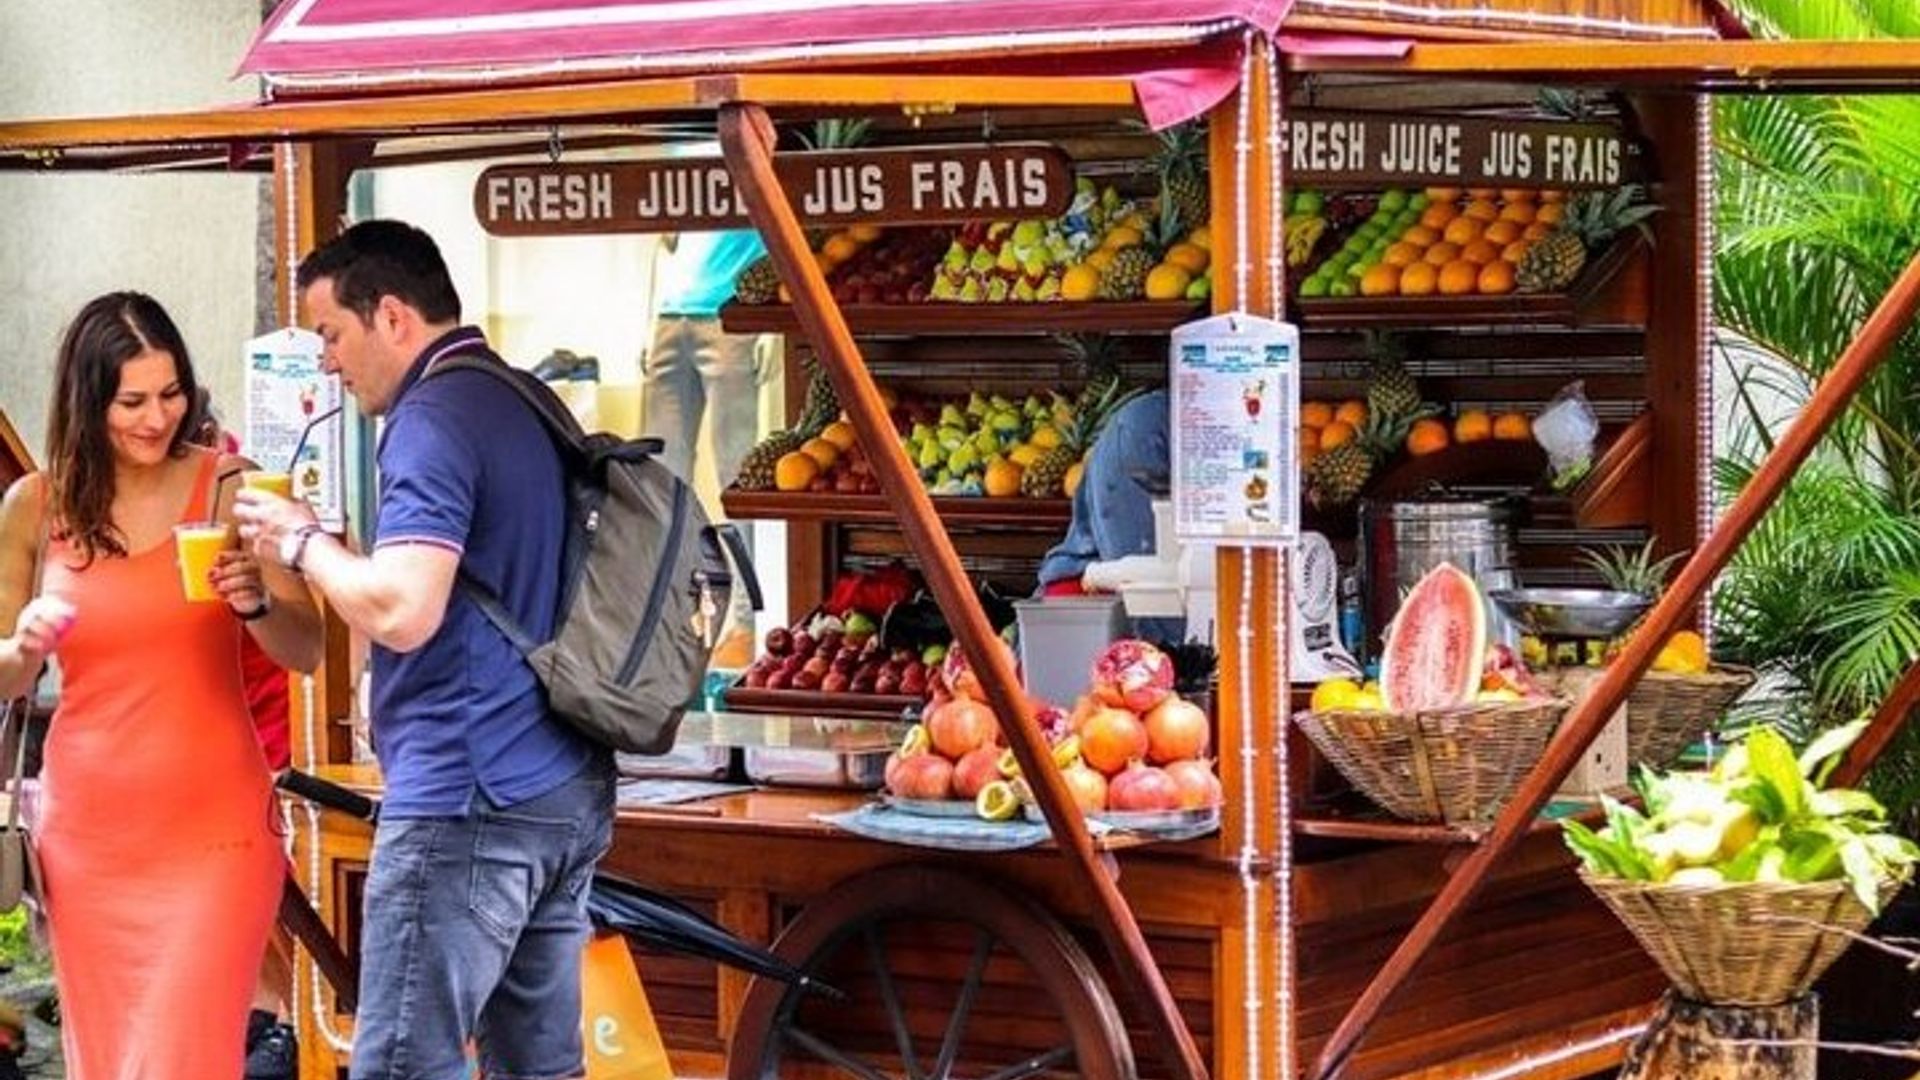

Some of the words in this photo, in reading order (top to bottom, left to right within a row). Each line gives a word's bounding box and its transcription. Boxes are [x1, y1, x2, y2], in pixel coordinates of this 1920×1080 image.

[1380, 123, 1461, 175] JUICE
[1482, 131, 1532, 179] JUS
[1545, 135, 1620, 184] FRAIS
[487, 173, 613, 222] FRESH
[804, 165, 884, 214] JUS
[911, 158, 1048, 211] FRAIS
